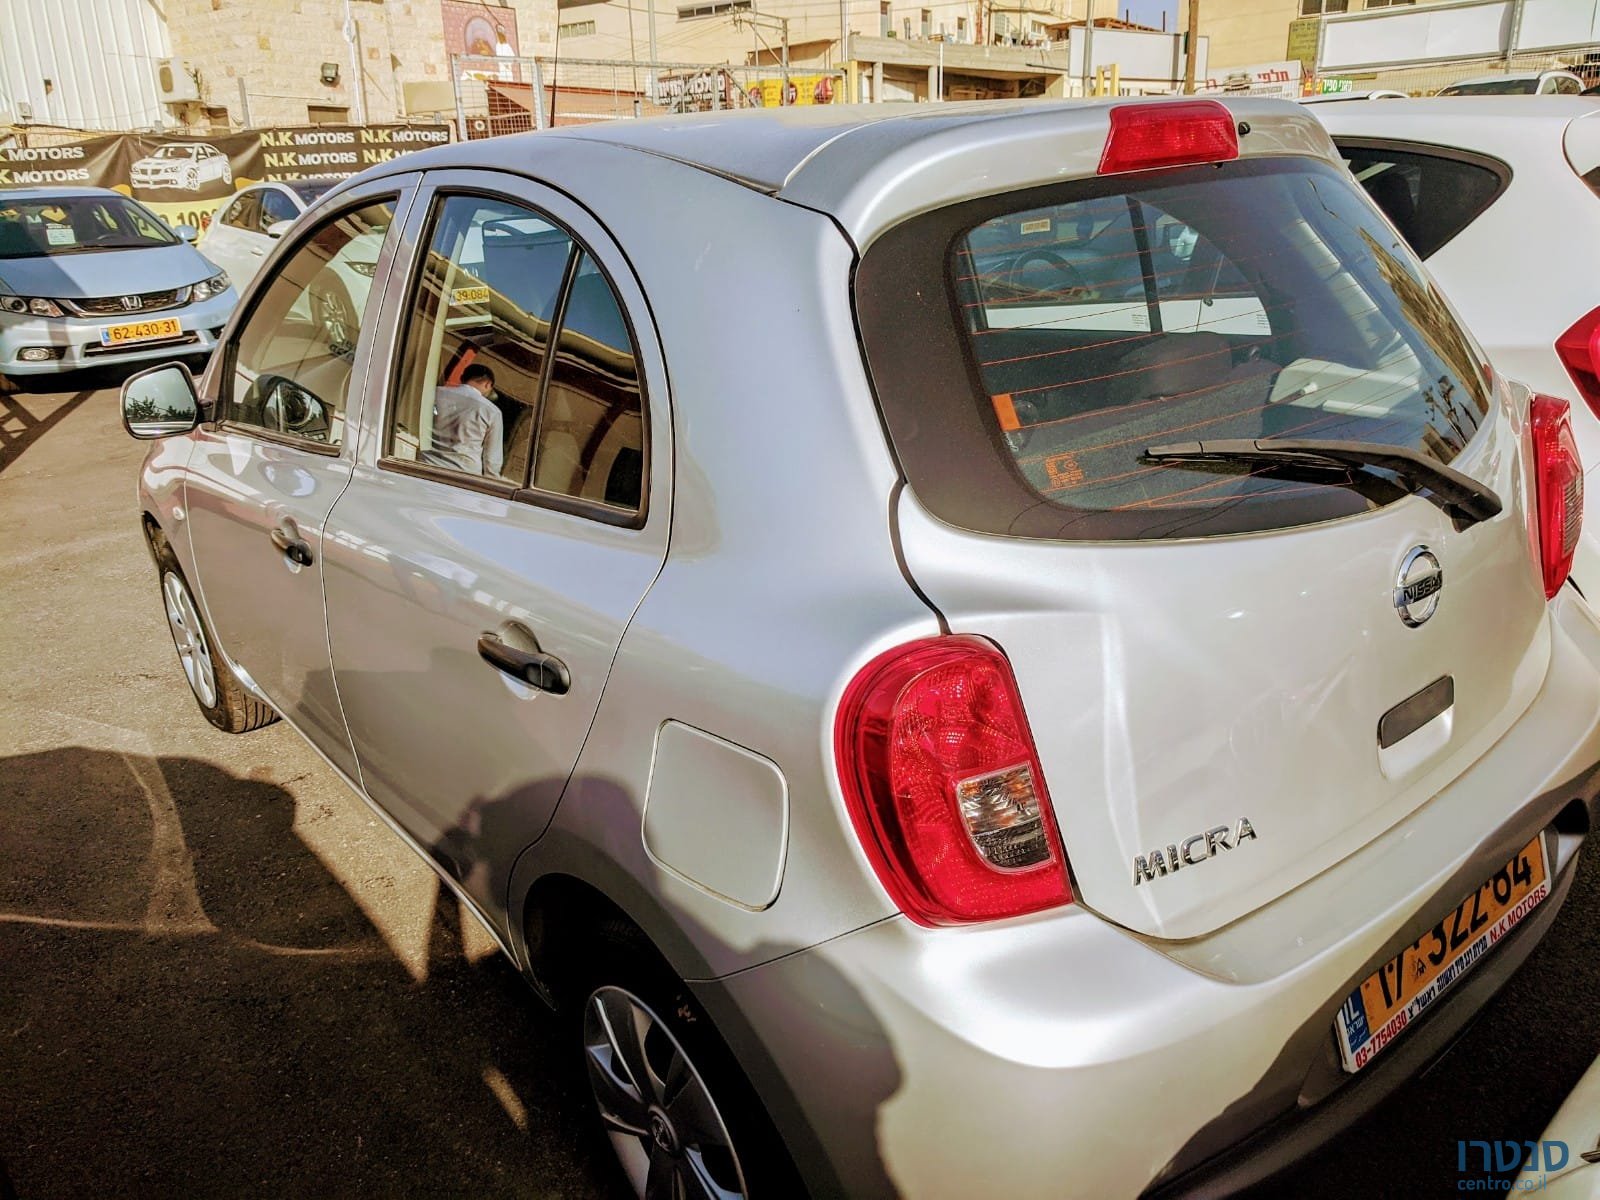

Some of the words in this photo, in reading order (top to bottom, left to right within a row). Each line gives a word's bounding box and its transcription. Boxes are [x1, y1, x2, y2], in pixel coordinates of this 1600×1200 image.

[260, 131, 294, 147] N.K
[295, 132, 355, 146] MOTORS
[360, 129, 392, 144] N.K
[392, 130, 449, 143] MOTORS
[7, 146, 85, 161] MOTORS
[264, 152, 299, 168] N.K
[298, 151, 358, 166] MOTORS
[12, 168, 90, 184] MOTORS
[1132, 816, 1258, 887] MICRA
[1507, 884, 1547, 927] MOTORS
[1489, 918, 1506, 944] N.K
[1344, 996, 1360, 1025] IL
[1355, 1008, 1408, 1069] 03-7754030
